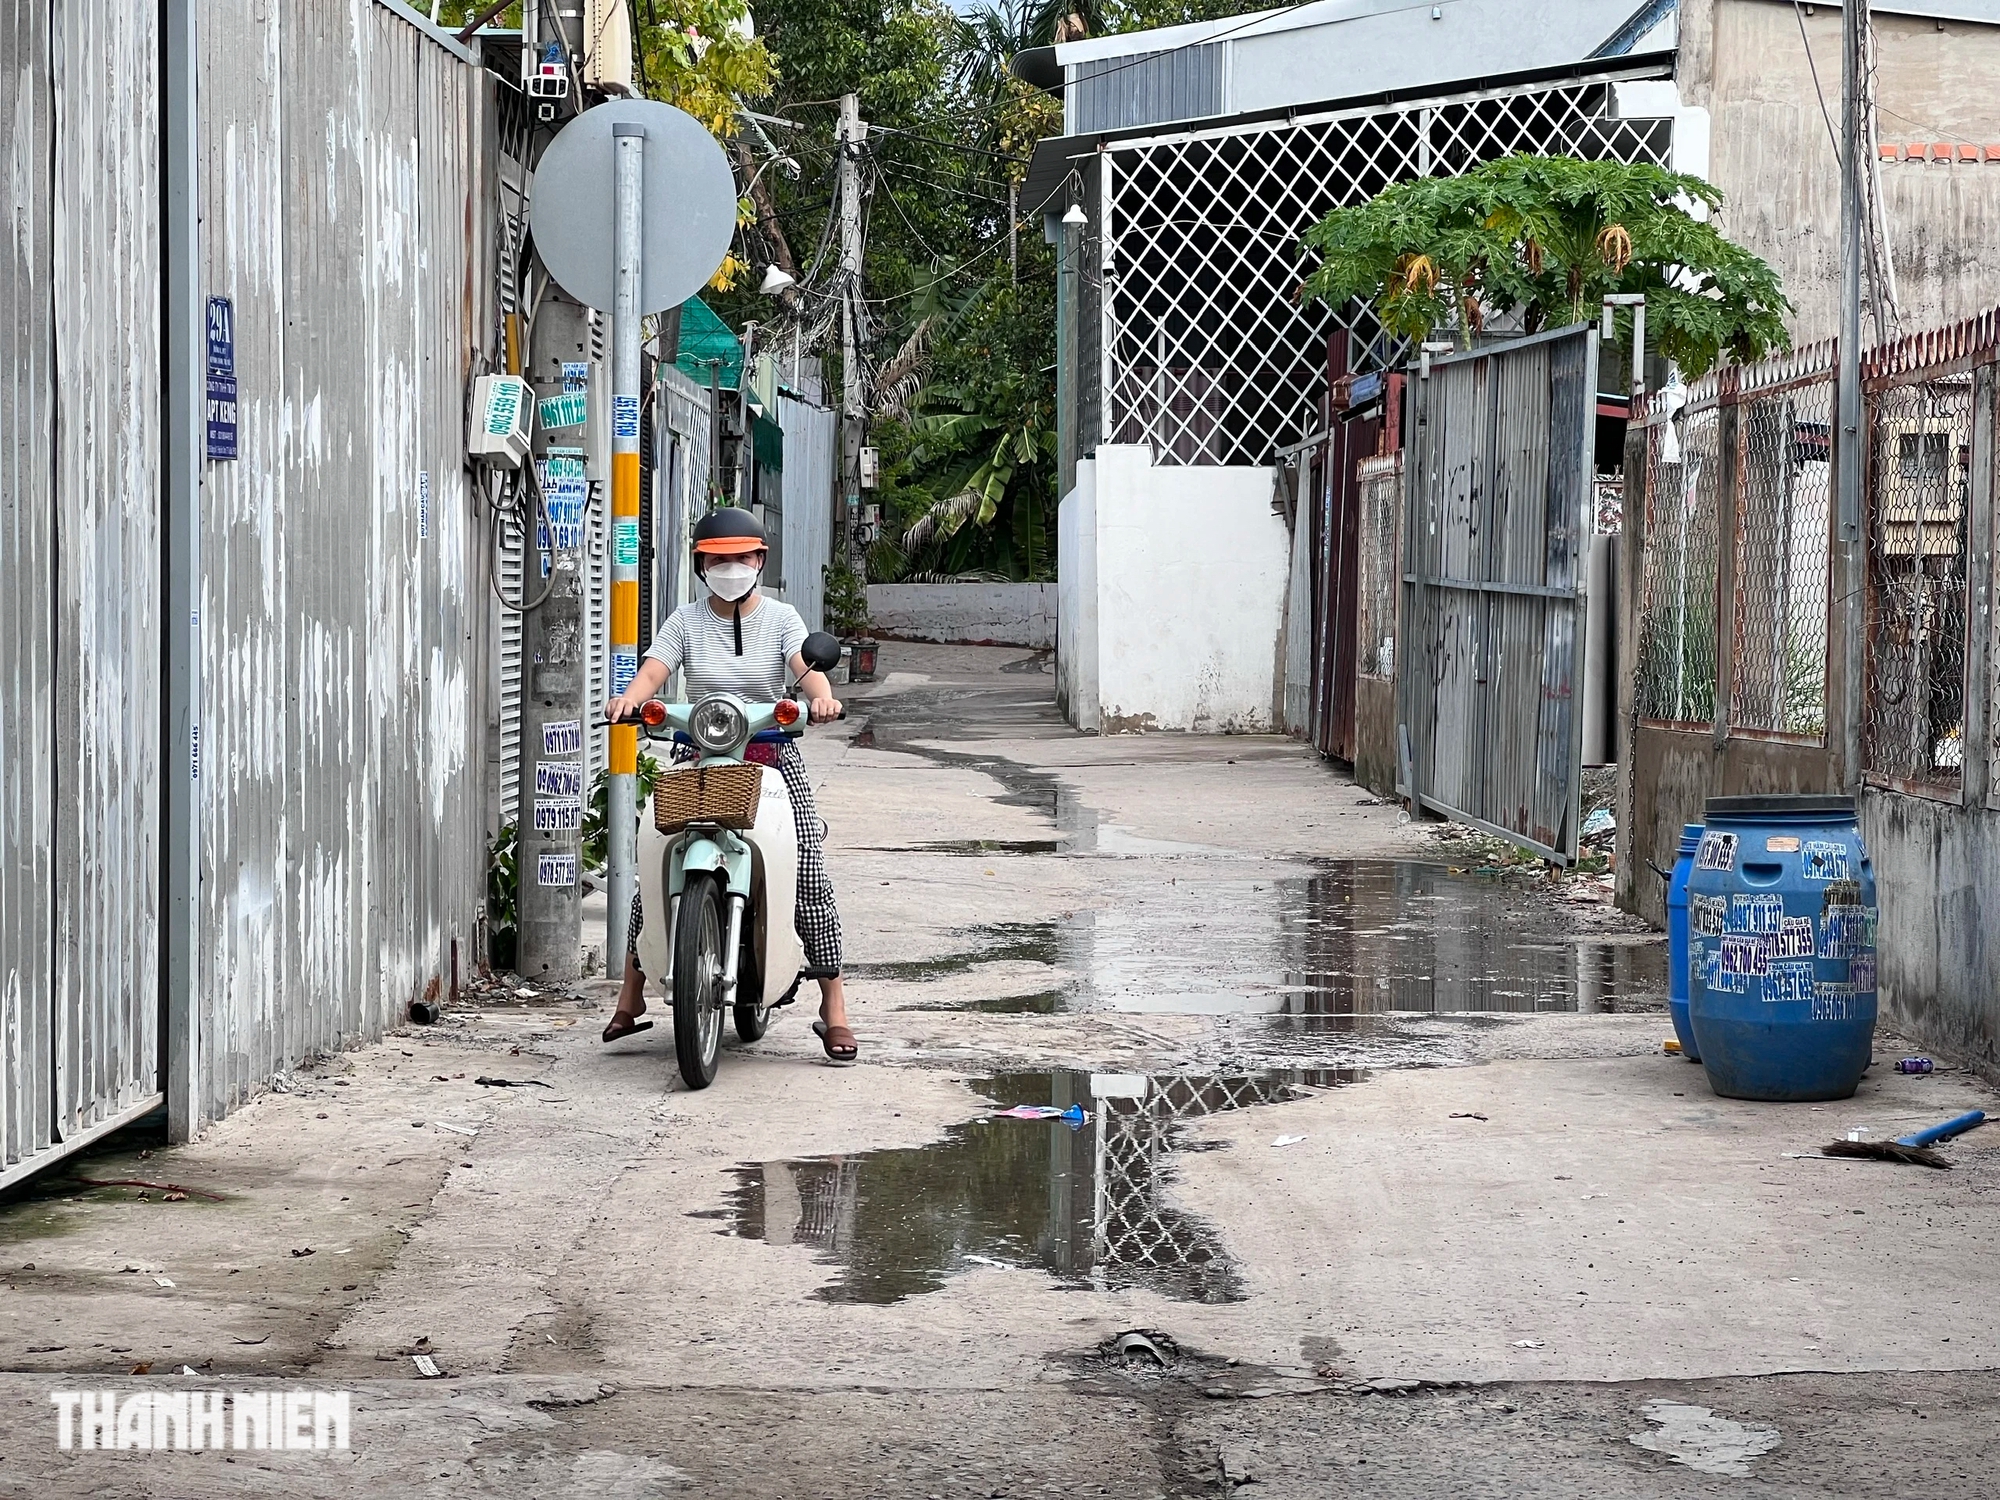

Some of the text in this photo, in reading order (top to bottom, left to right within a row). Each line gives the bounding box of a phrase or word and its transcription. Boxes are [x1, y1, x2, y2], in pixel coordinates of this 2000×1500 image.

[209, 303, 231, 343] 29A
[207, 399, 236, 424] APT KENG
[1733, 903, 1782, 931] 0987.911.337
